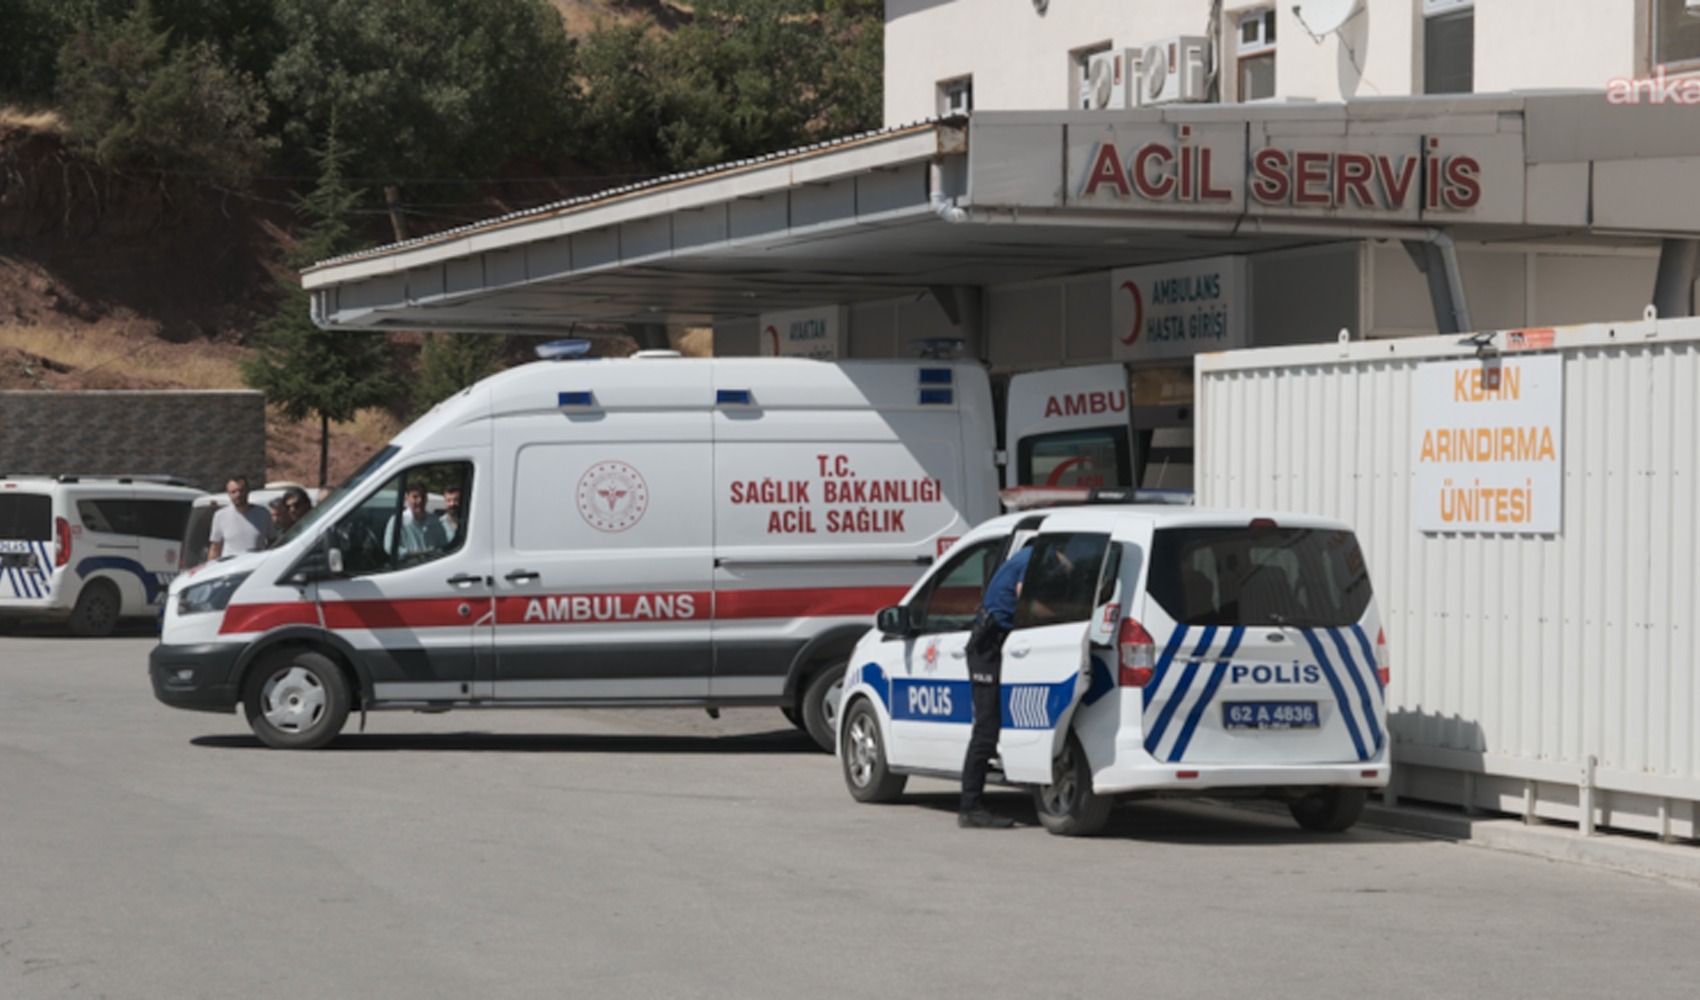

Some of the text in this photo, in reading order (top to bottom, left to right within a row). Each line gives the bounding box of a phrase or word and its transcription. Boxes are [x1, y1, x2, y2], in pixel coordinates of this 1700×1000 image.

[1084, 124, 1482, 209] ACİL SERVİS
[1152, 273, 1221, 304] AMBULANS
[1146, 304, 1228, 342] HASTA GİRİŞİ
[1044, 389, 1127, 418] AMBU
[1420, 426, 1556, 462] ARINDIRMA
[816, 454, 856, 478] T.C.
[730, 477, 941, 504] SAĞLIK BAKANLIĞI
[1440, 478, 1532, 523] ÜNİTESİ
[767, 506, 905, 533] ACİL SAĞLIK
[524, 594, 695, 621] AMBULANS
[1230, 660, 1321, 684] POLİS
[907, 685, 953, 716] POLİS
[1229, 705, 1315, 722] 62 A 4836
